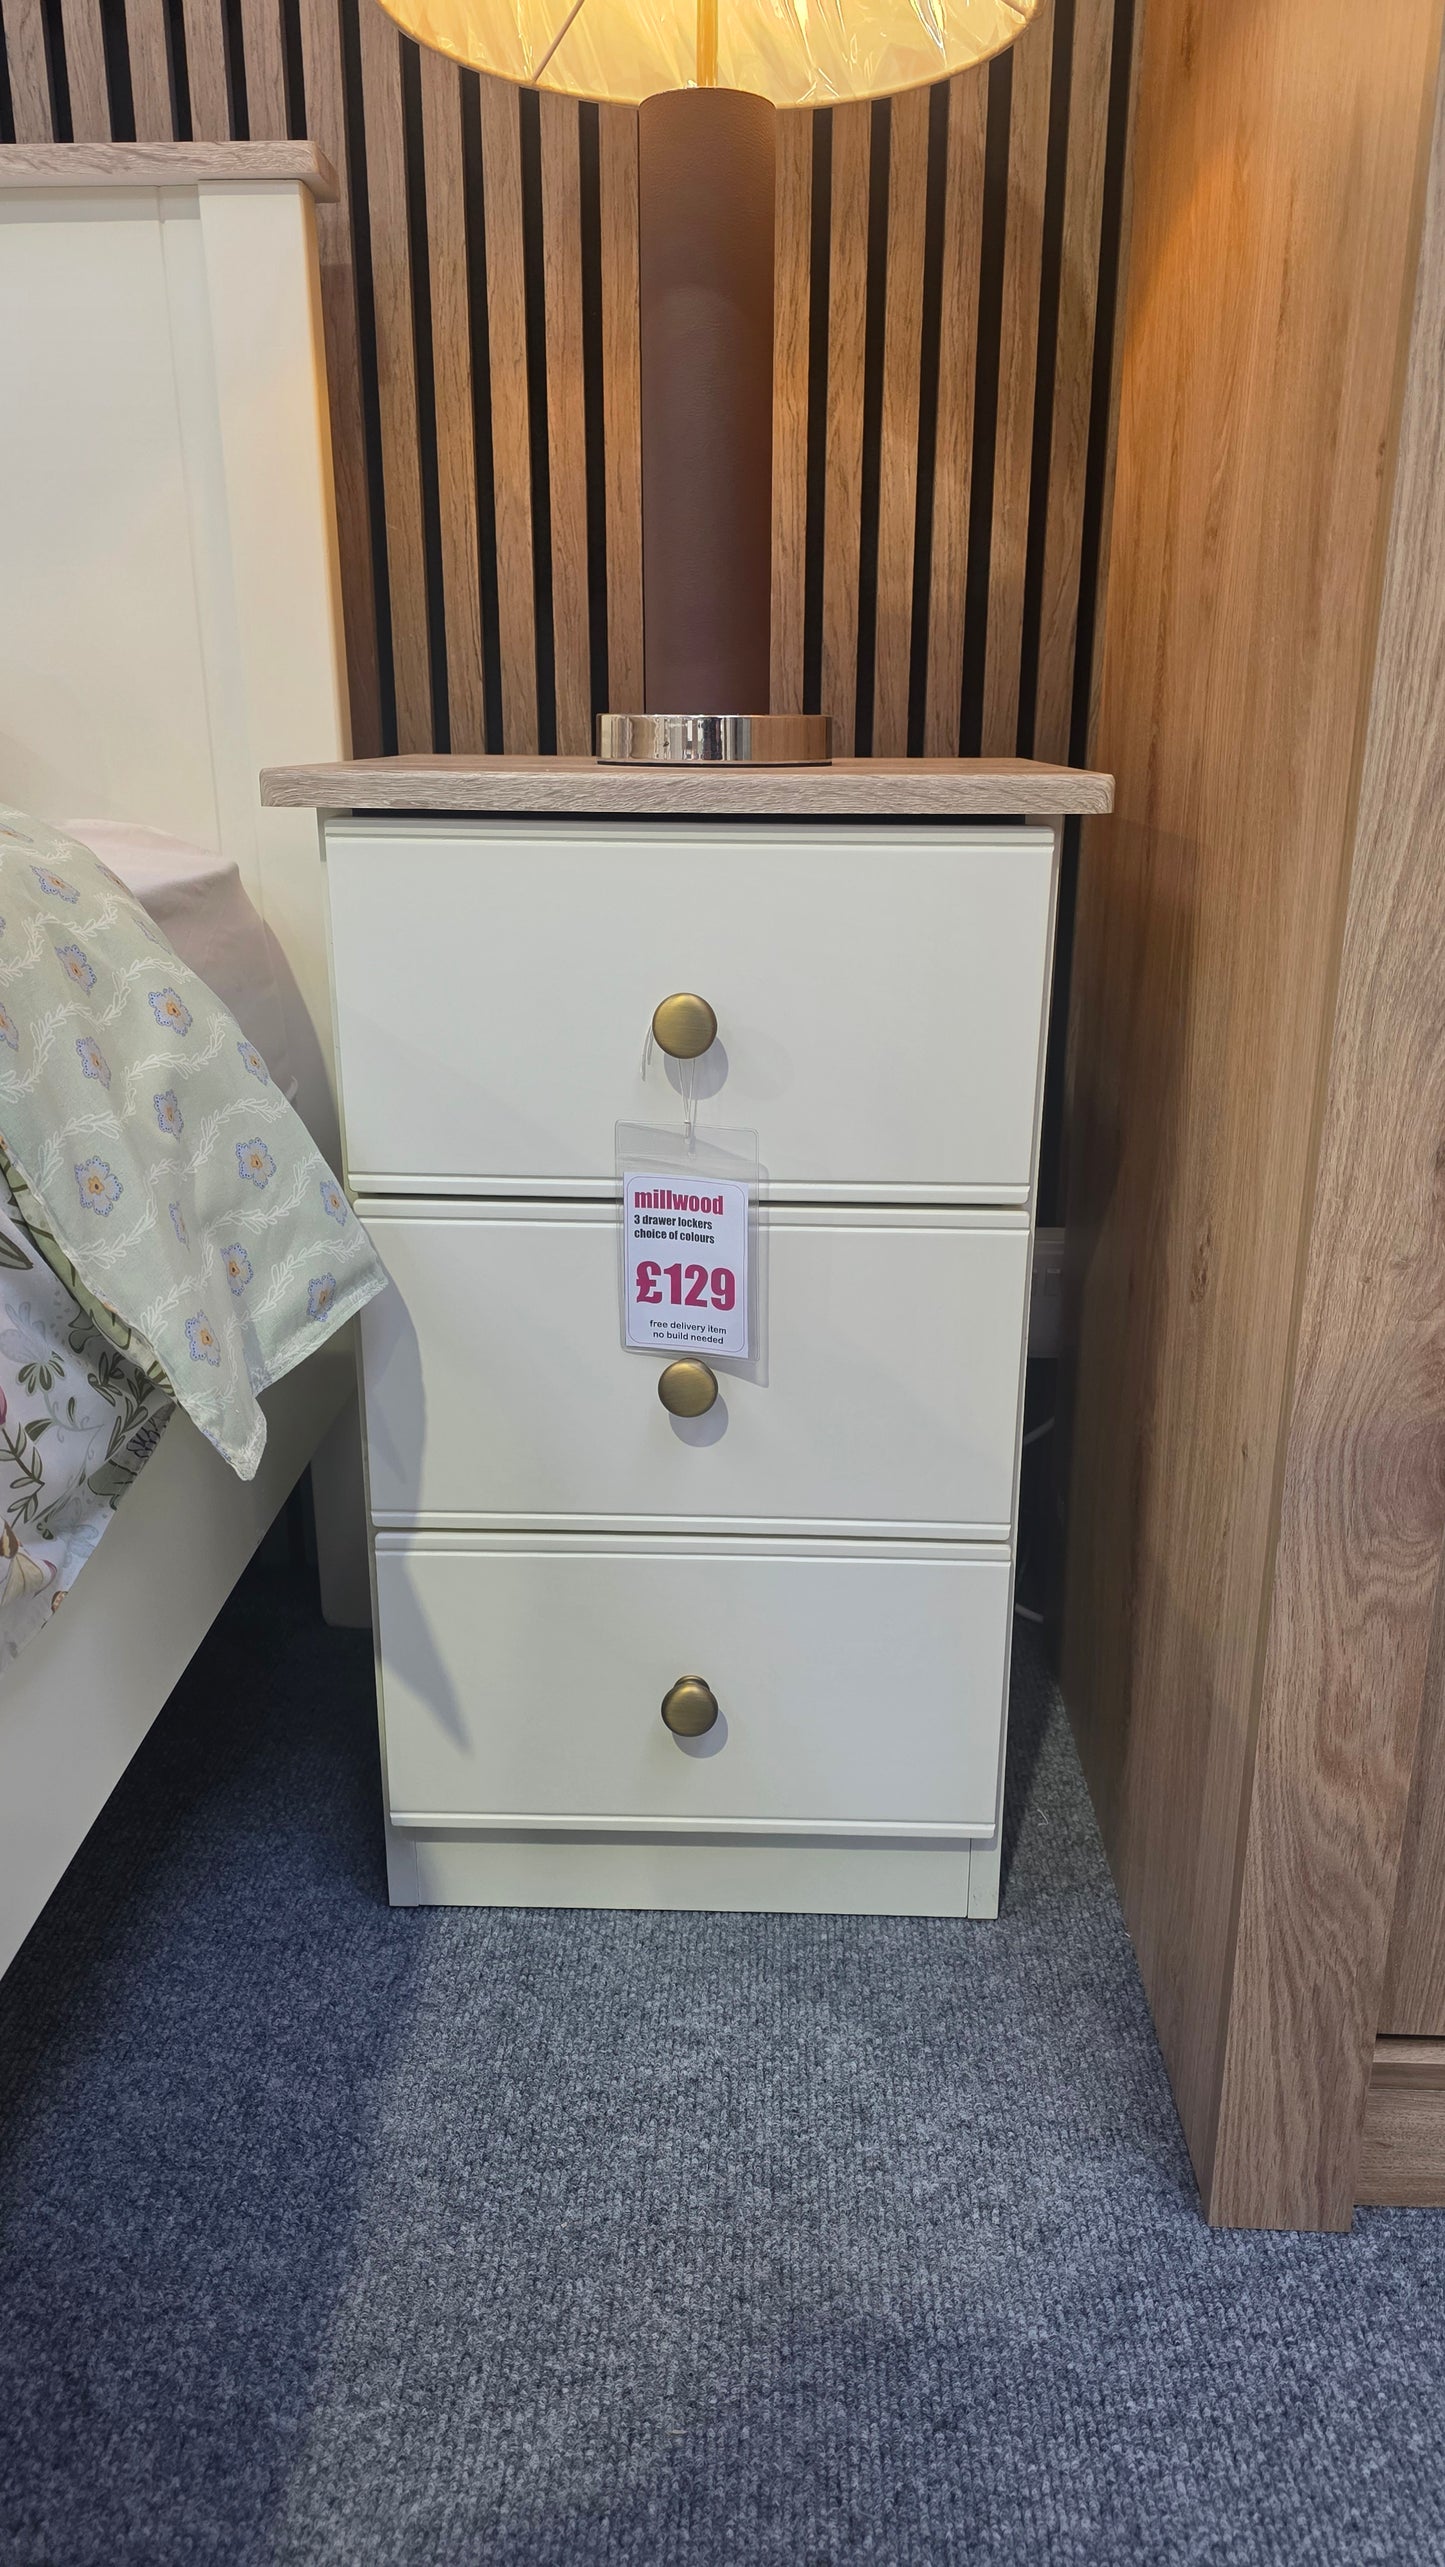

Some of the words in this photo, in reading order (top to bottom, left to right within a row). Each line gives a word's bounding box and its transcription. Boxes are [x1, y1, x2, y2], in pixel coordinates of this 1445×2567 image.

[634, 1189, 724, 1215] millwood
[634, 1214, 641, 1225] 3
[642, 1215, 677, 1227] drawer
[678, 1216, 713, 1230] lockers
[634, 1228, 667, 1240] choice
[668, 1230, 679, 1240] of
[680, 1231, 715, 1244] colours
[636, 1261, 736, 1311] £129
[649, 1320, 668, 1328] free
[670, 1321, 706, 1334] delivery
[707, 1324, 727, 1335] item
[653, 1331, 665, 1339] no
[666, 1330, 689, 1340] build
[690, 1334, 724, 1345] needed
